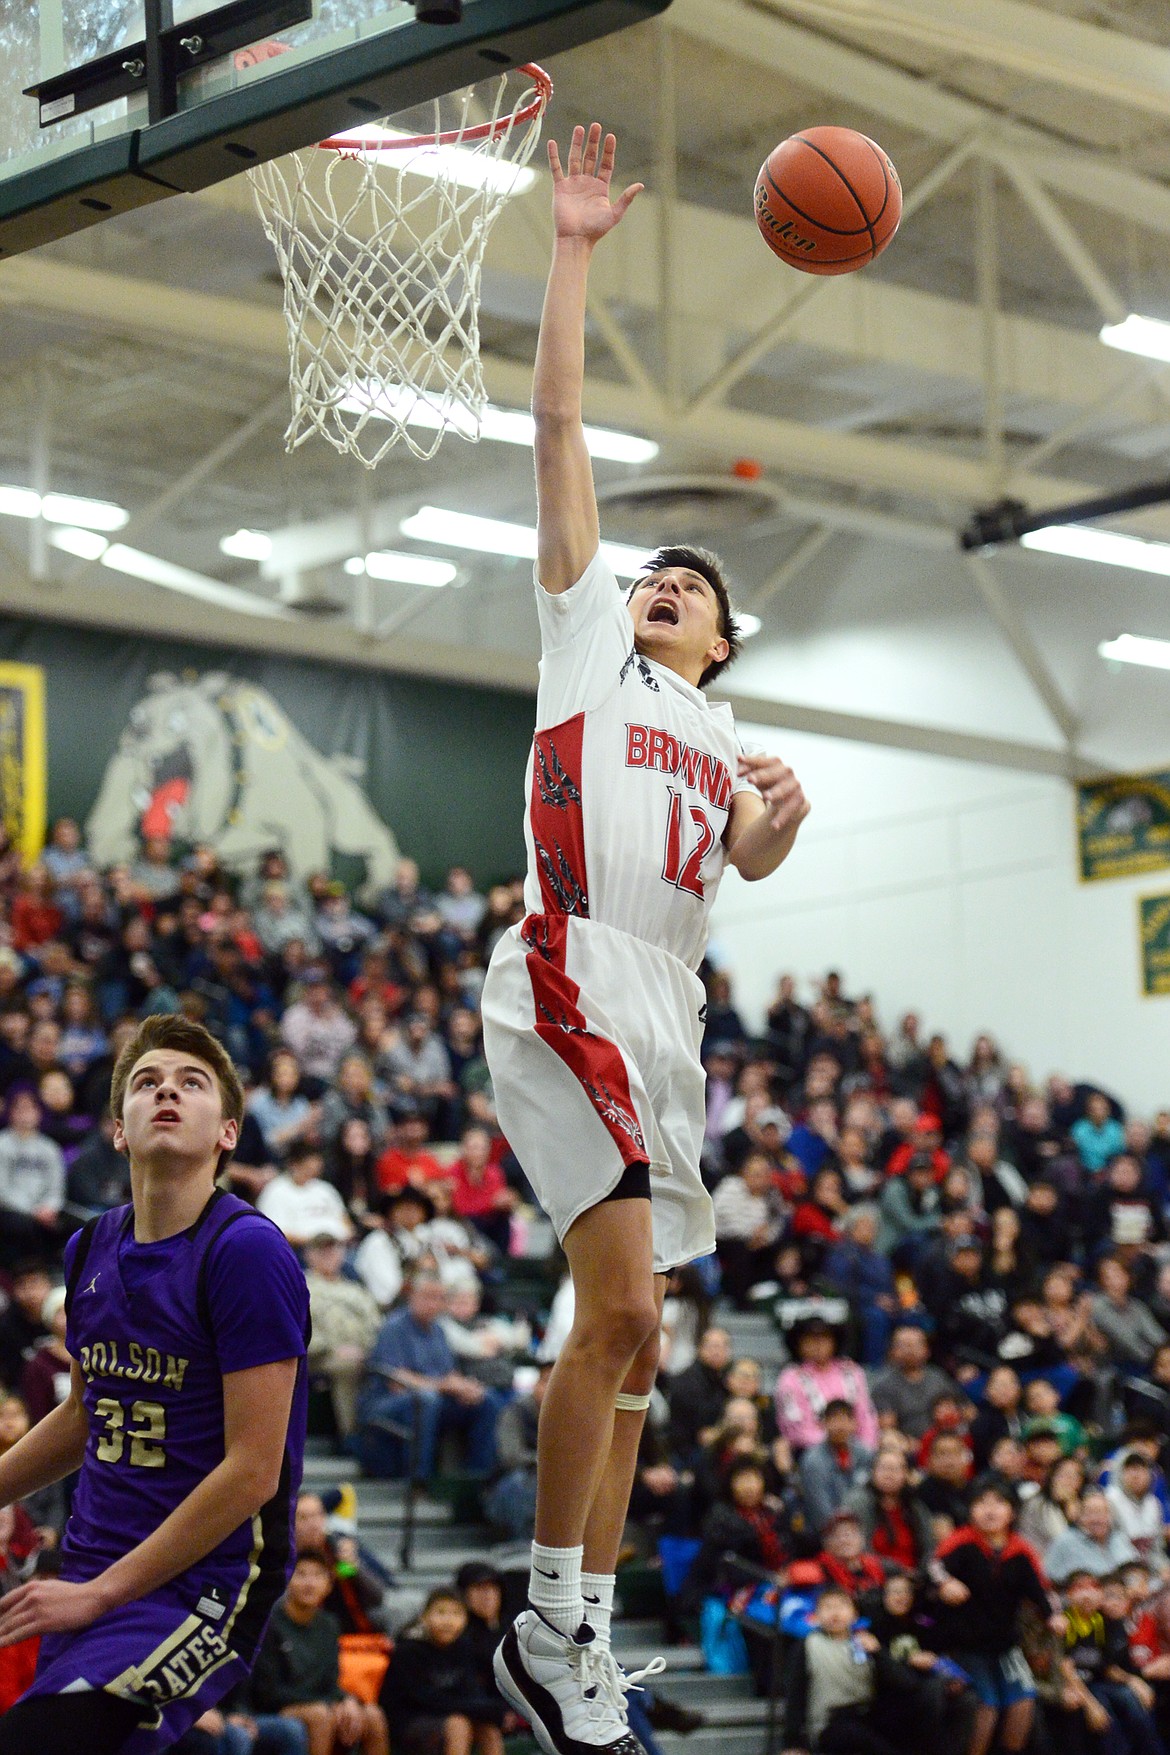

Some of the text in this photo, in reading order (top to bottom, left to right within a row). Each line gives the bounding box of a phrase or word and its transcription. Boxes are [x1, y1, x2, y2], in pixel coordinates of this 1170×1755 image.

[661, 785, 715, 901] 12
[80, 1340, 190, 1392] POLSON
[94, 1397, 167, 1468] 32
